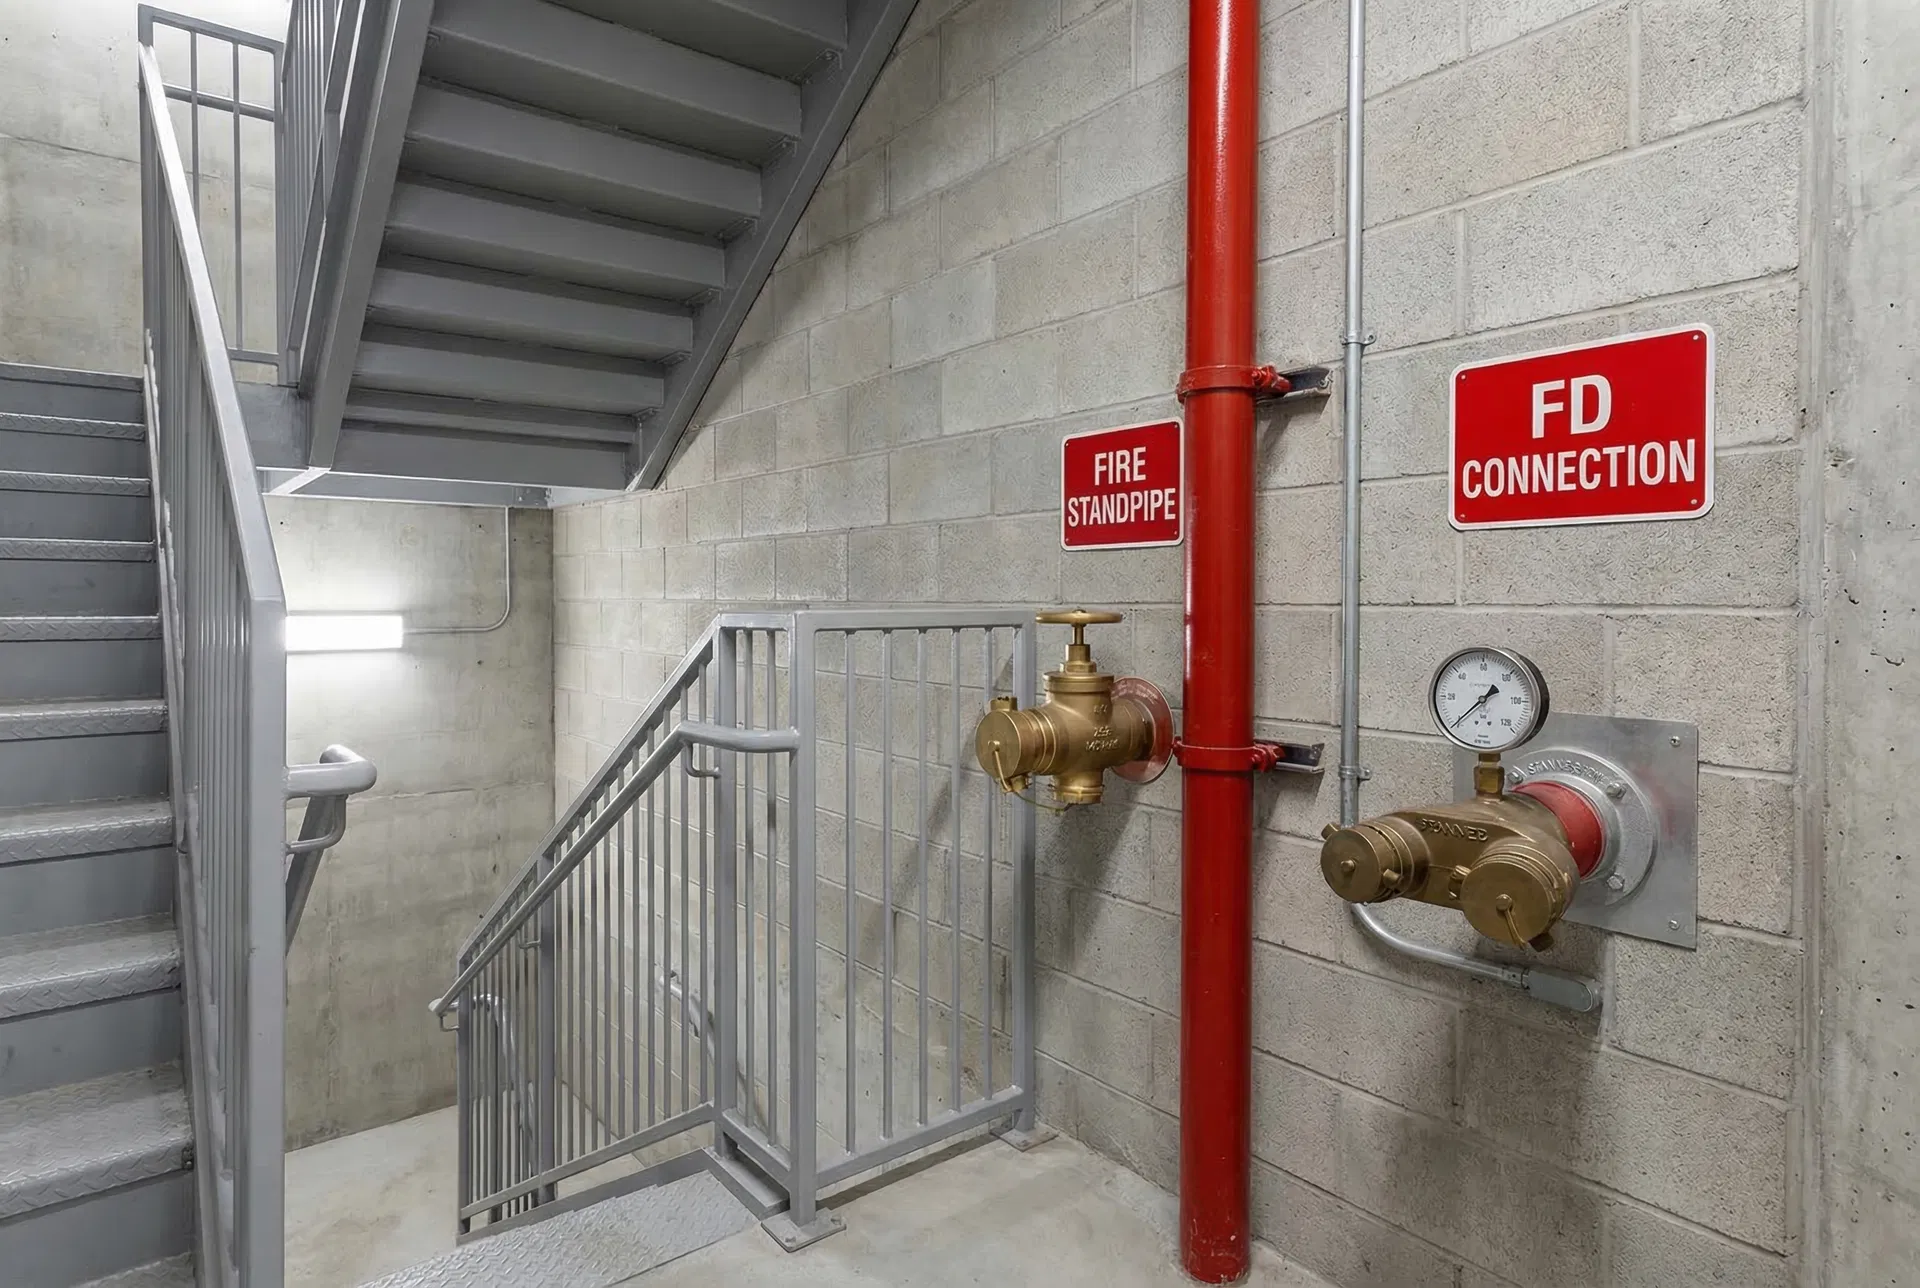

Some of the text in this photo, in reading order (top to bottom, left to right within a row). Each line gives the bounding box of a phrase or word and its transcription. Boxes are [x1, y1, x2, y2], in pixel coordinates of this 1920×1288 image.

[1532, 374, 1612, 439] FD
[1094, 446, 1147, 486] FIRE
[1462, 438, 1696, 499] CONNECTION
[1067, 488, 1176, 528] STANDPIPE
